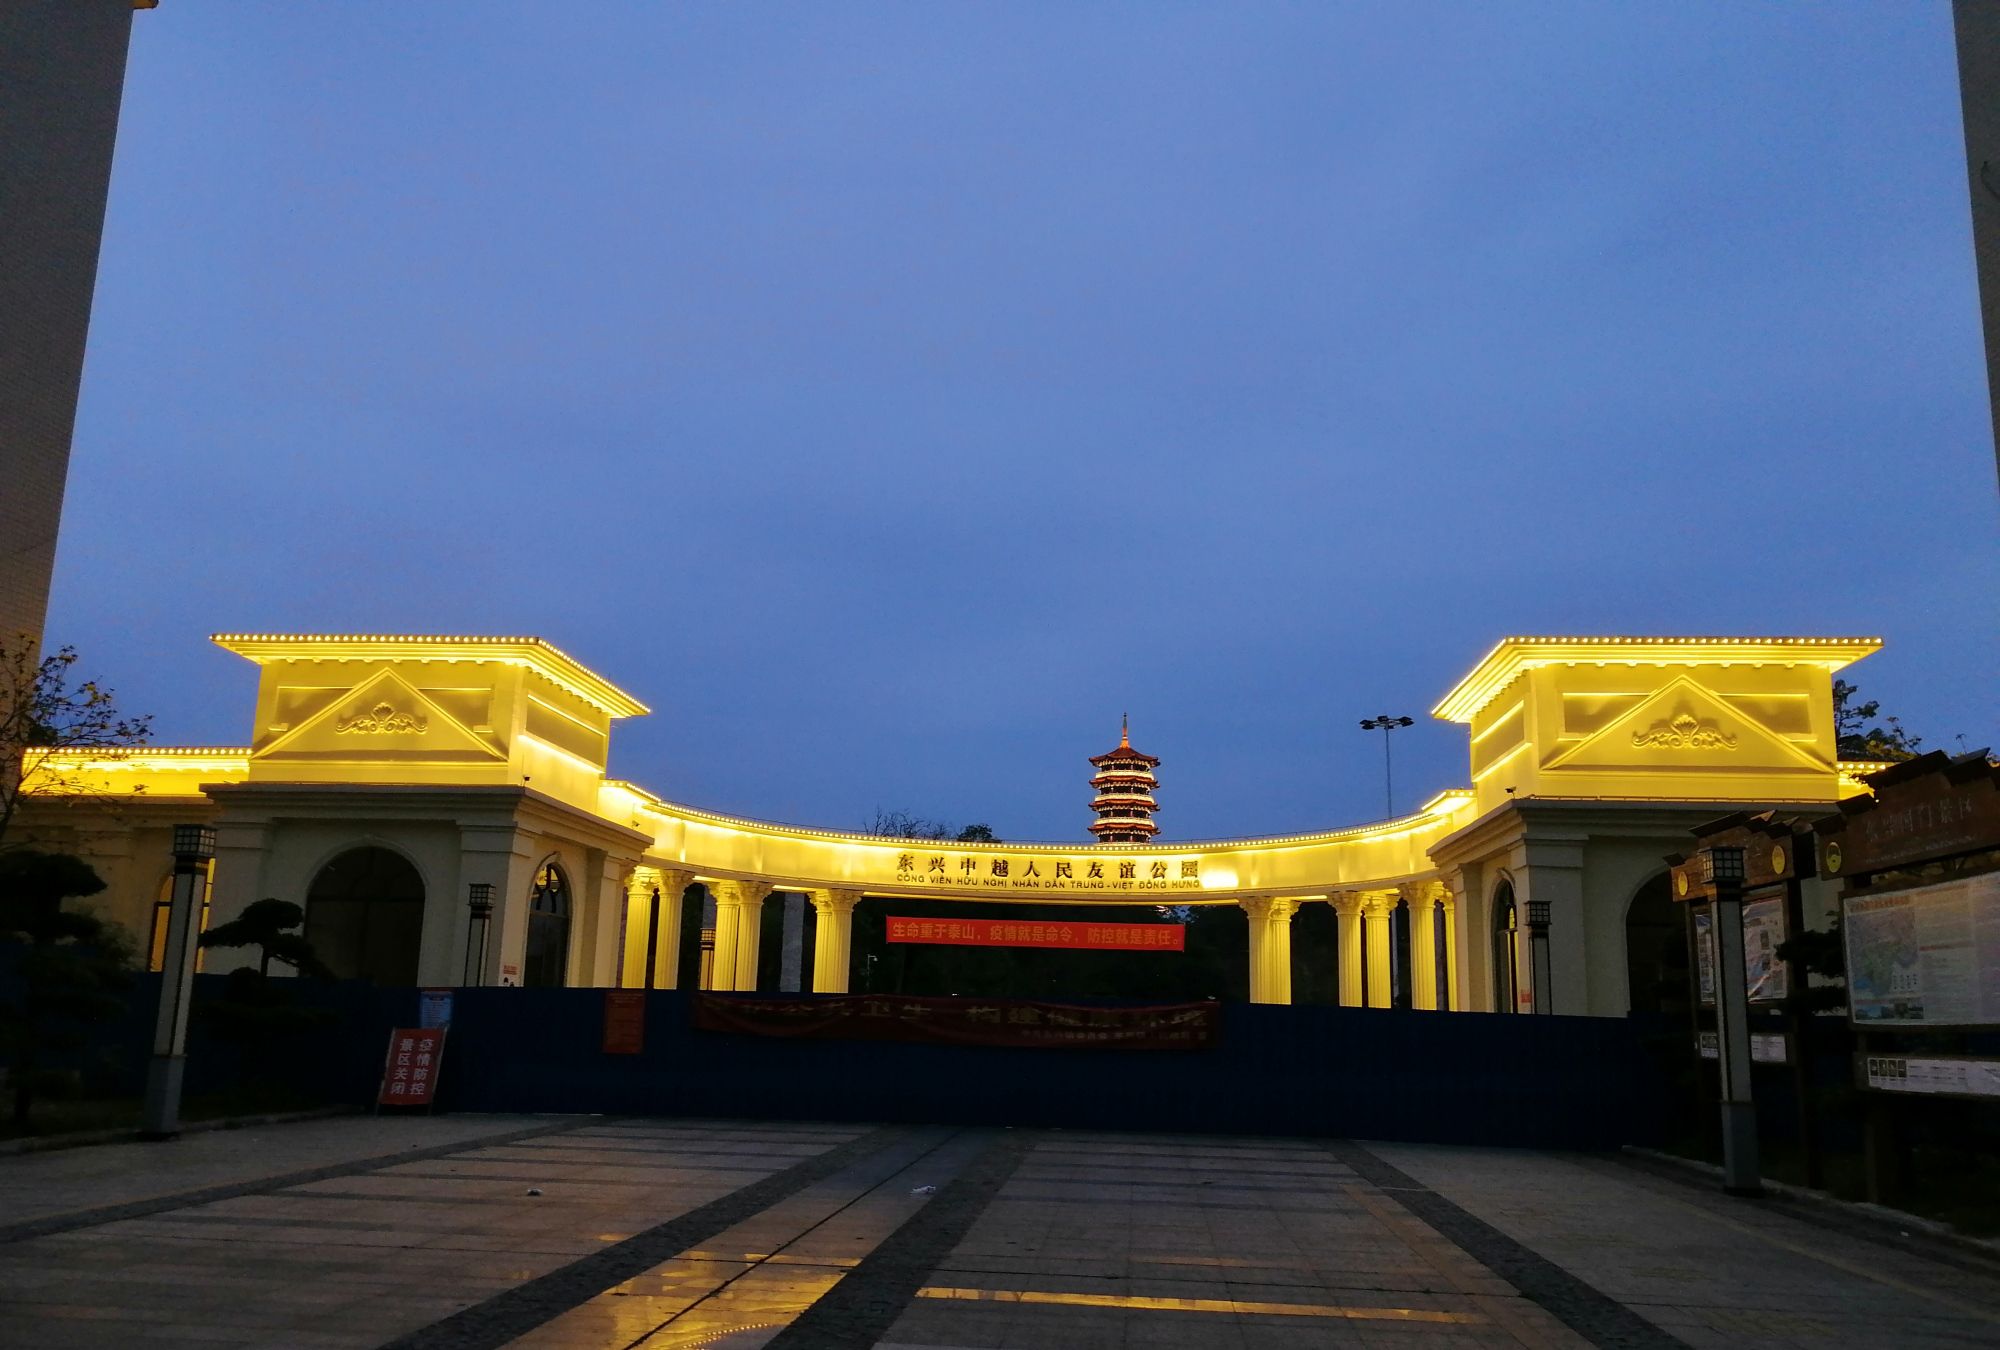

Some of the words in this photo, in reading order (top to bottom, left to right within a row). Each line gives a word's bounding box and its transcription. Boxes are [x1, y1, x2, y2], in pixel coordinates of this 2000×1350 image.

[897, 854, 1198, 879] 东兴中越人民友谊公园
[897, 873, 924, 883] CÔNG
[930, 875, 952, 884] VIÊN
[390, 1037, 415, 1096] 景区关闭
[409, 1038, 435, 1096] 疫情防控
